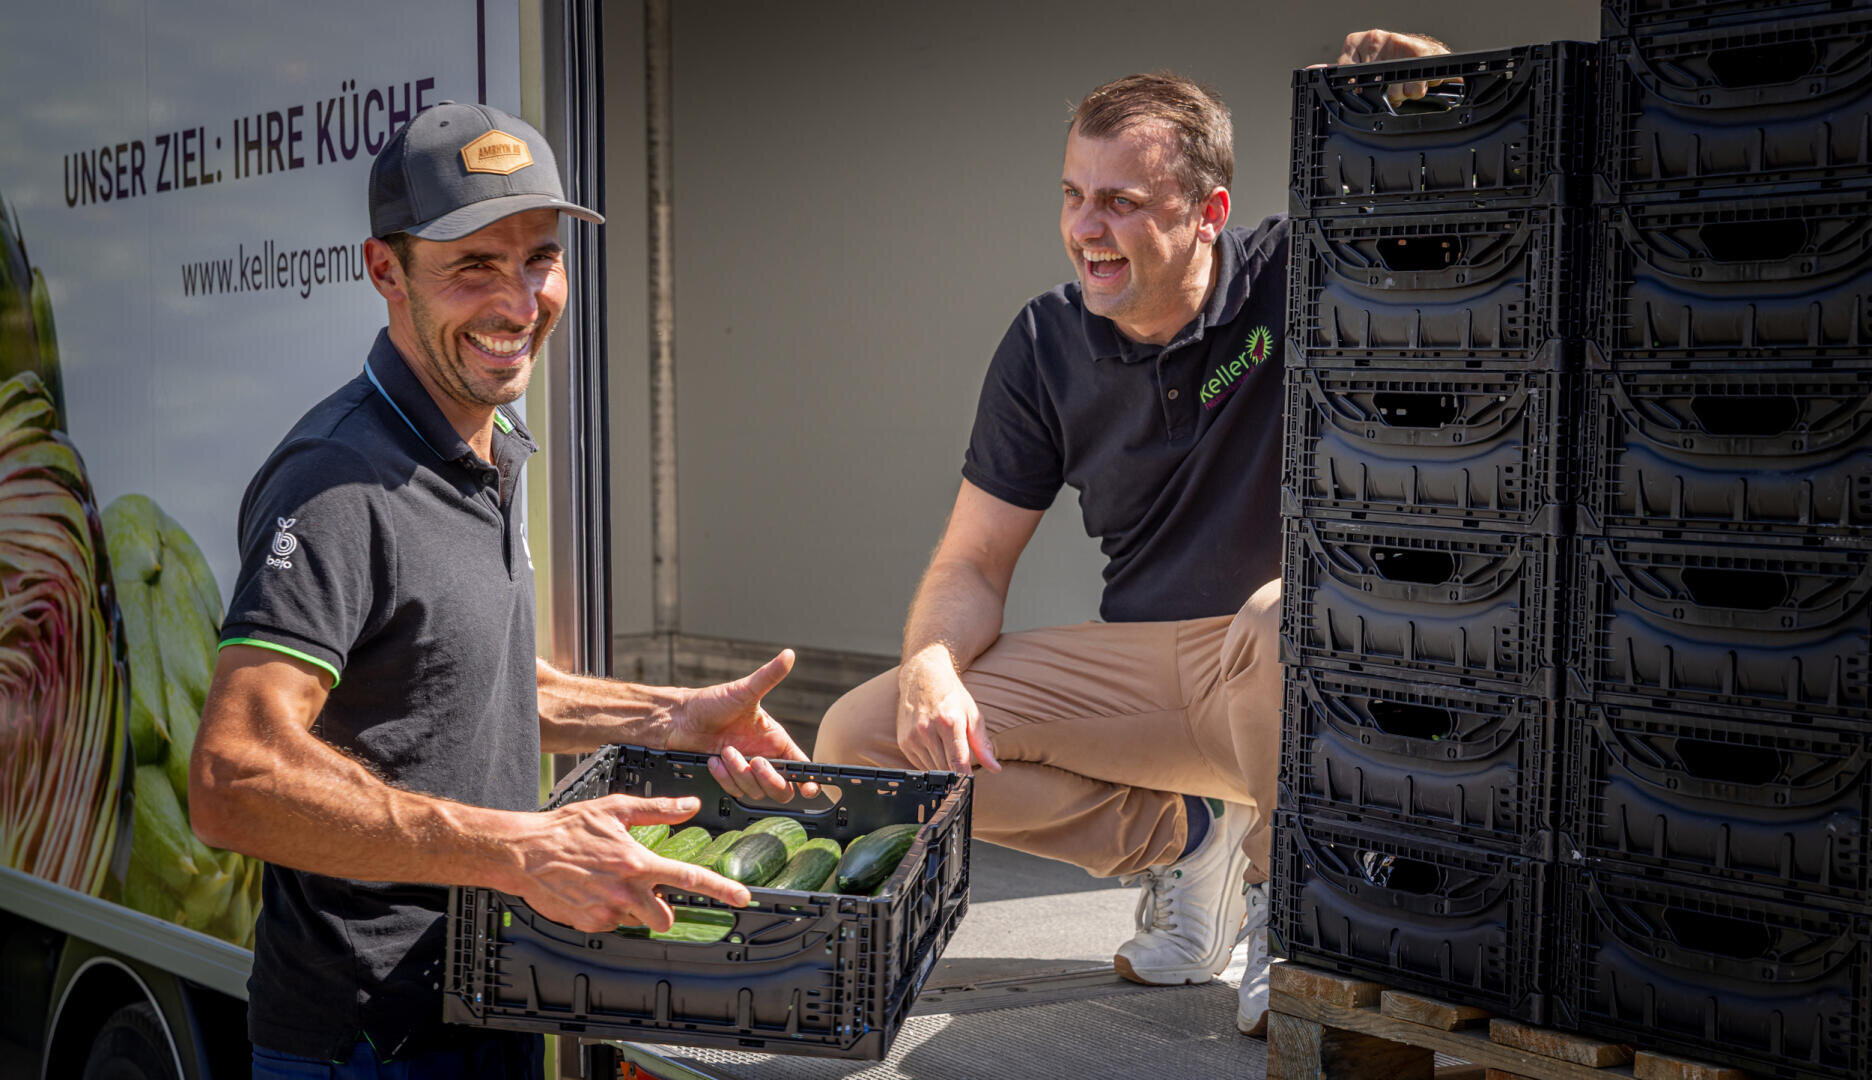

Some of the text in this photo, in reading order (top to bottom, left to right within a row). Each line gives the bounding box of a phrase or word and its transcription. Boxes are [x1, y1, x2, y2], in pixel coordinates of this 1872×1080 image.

[64, 140, 147, 208] UNSER
[155, 126, 222, 193] ZIEL:
[234, 105, 304, 179] IHRE
[266, 555, 292, 570] bejo
